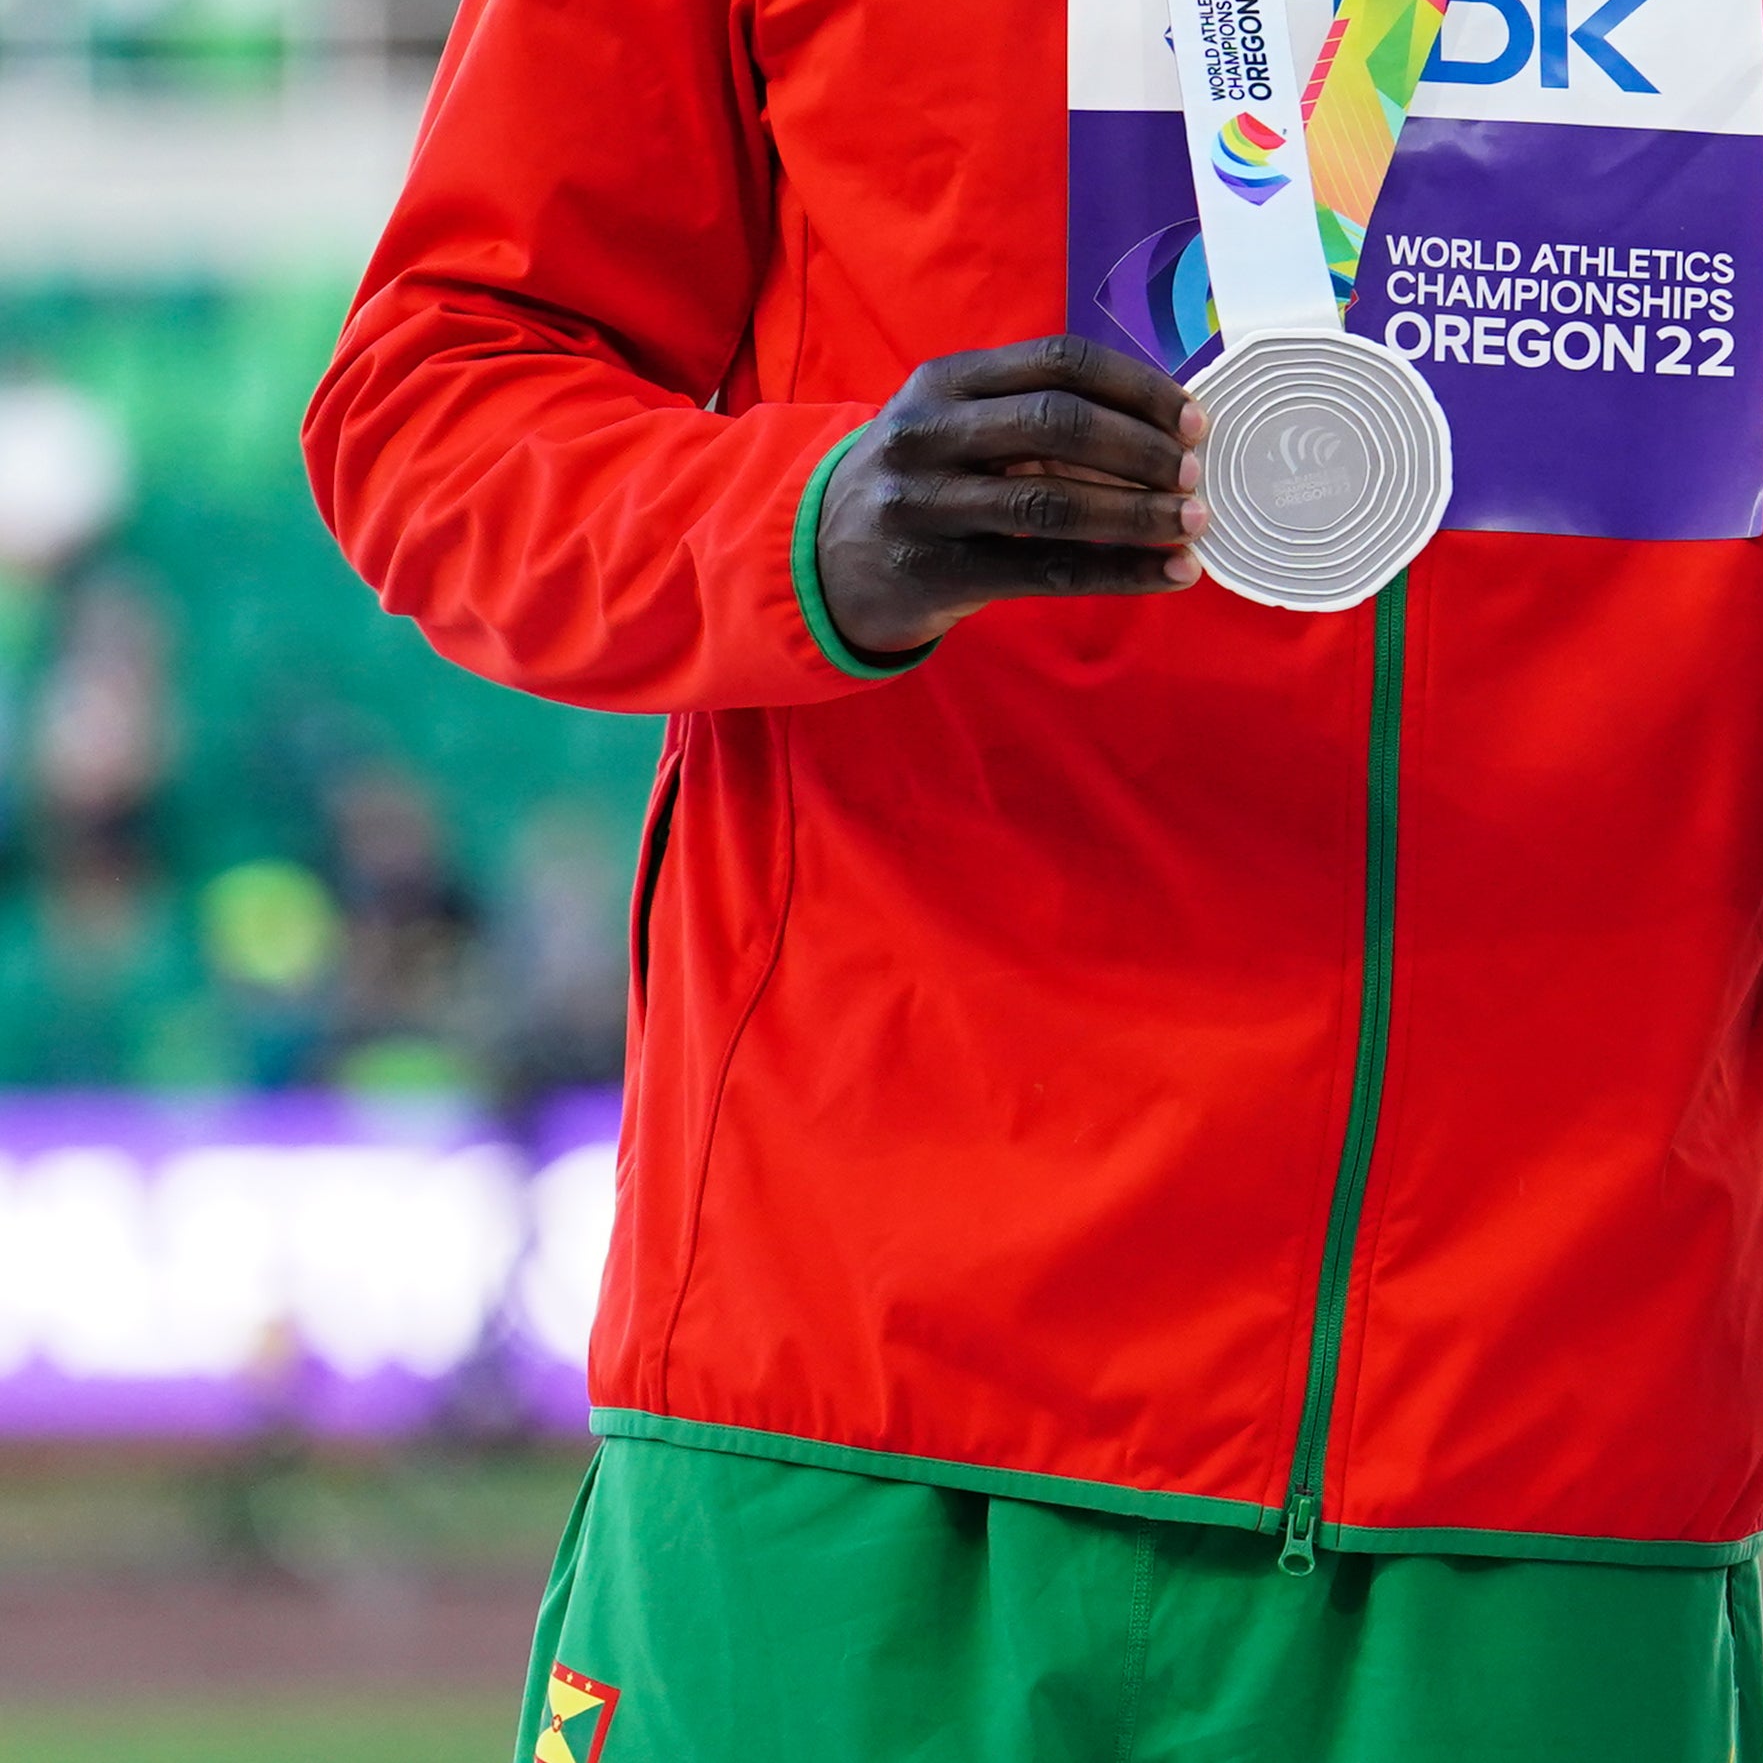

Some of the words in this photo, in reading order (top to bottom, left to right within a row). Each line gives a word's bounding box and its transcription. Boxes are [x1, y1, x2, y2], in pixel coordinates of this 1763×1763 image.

[1205, 47, 1227, 101] WORLD
[1385, 234, 1522, 273] WORLD
[1530, 243, 1735, 284] ATHLETICS
[1386, 270, 1735, 323] CHAMPIONSHIPS
[1384, 311, 1646, 373] OREGON
[1655, 325, 1735, 377] 22
